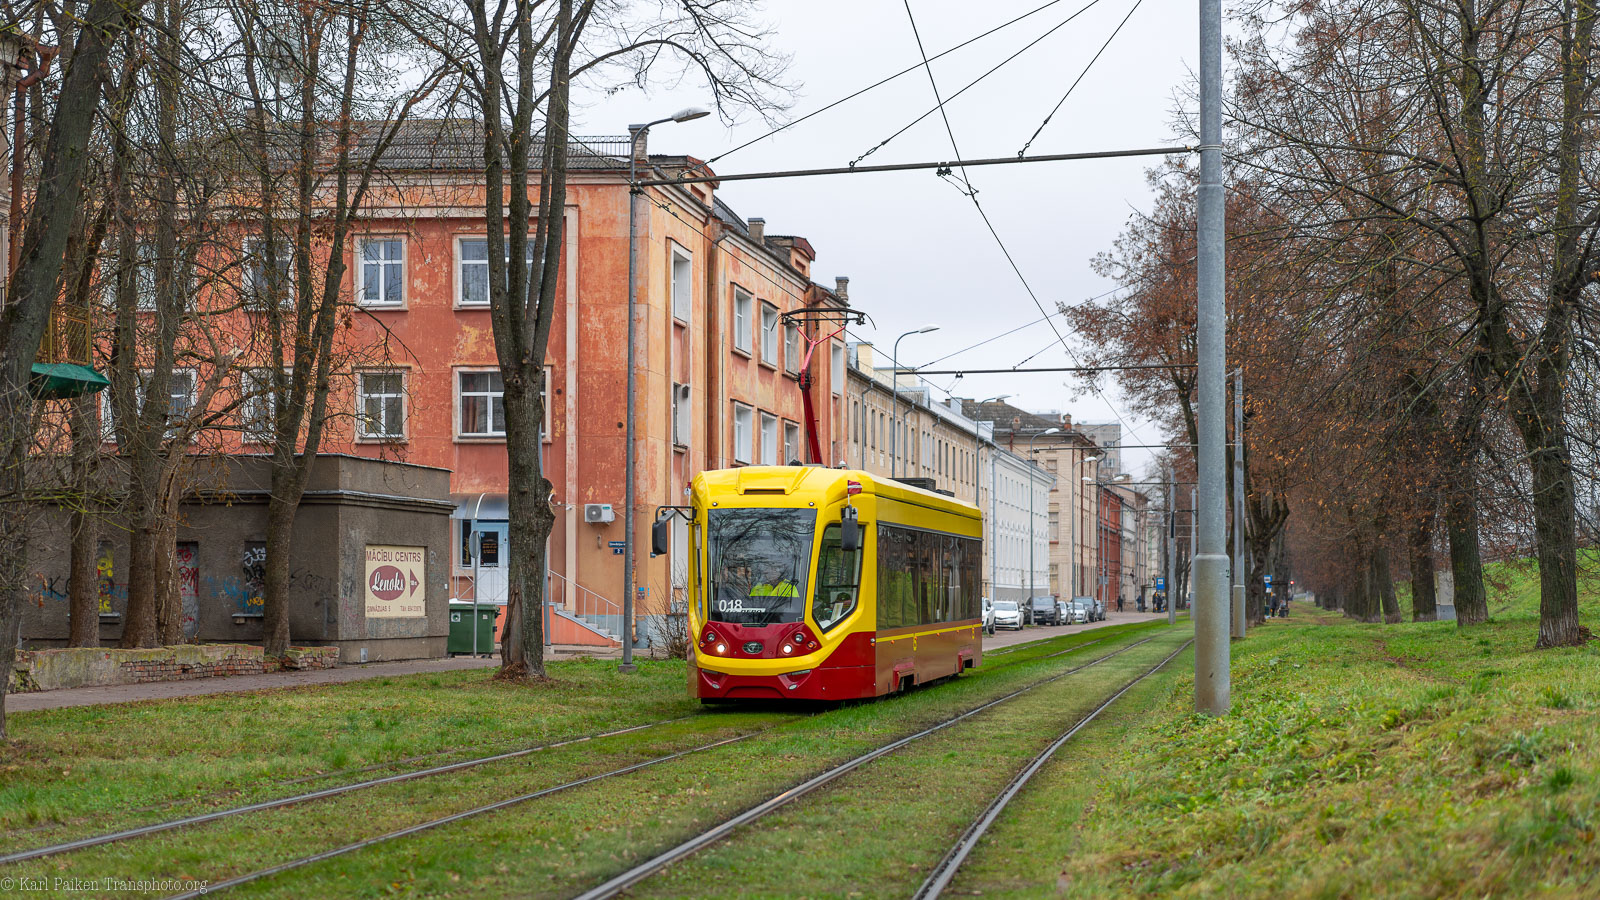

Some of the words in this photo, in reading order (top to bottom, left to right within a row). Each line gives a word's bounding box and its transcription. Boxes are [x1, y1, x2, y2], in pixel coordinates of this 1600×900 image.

[366, 549, 393, 561] MĀCĪBU
[395, 552, 421, 562] CENTRS
[372, 572, 404, 591] Lenoks
[718, 599, 743, 613] 018
